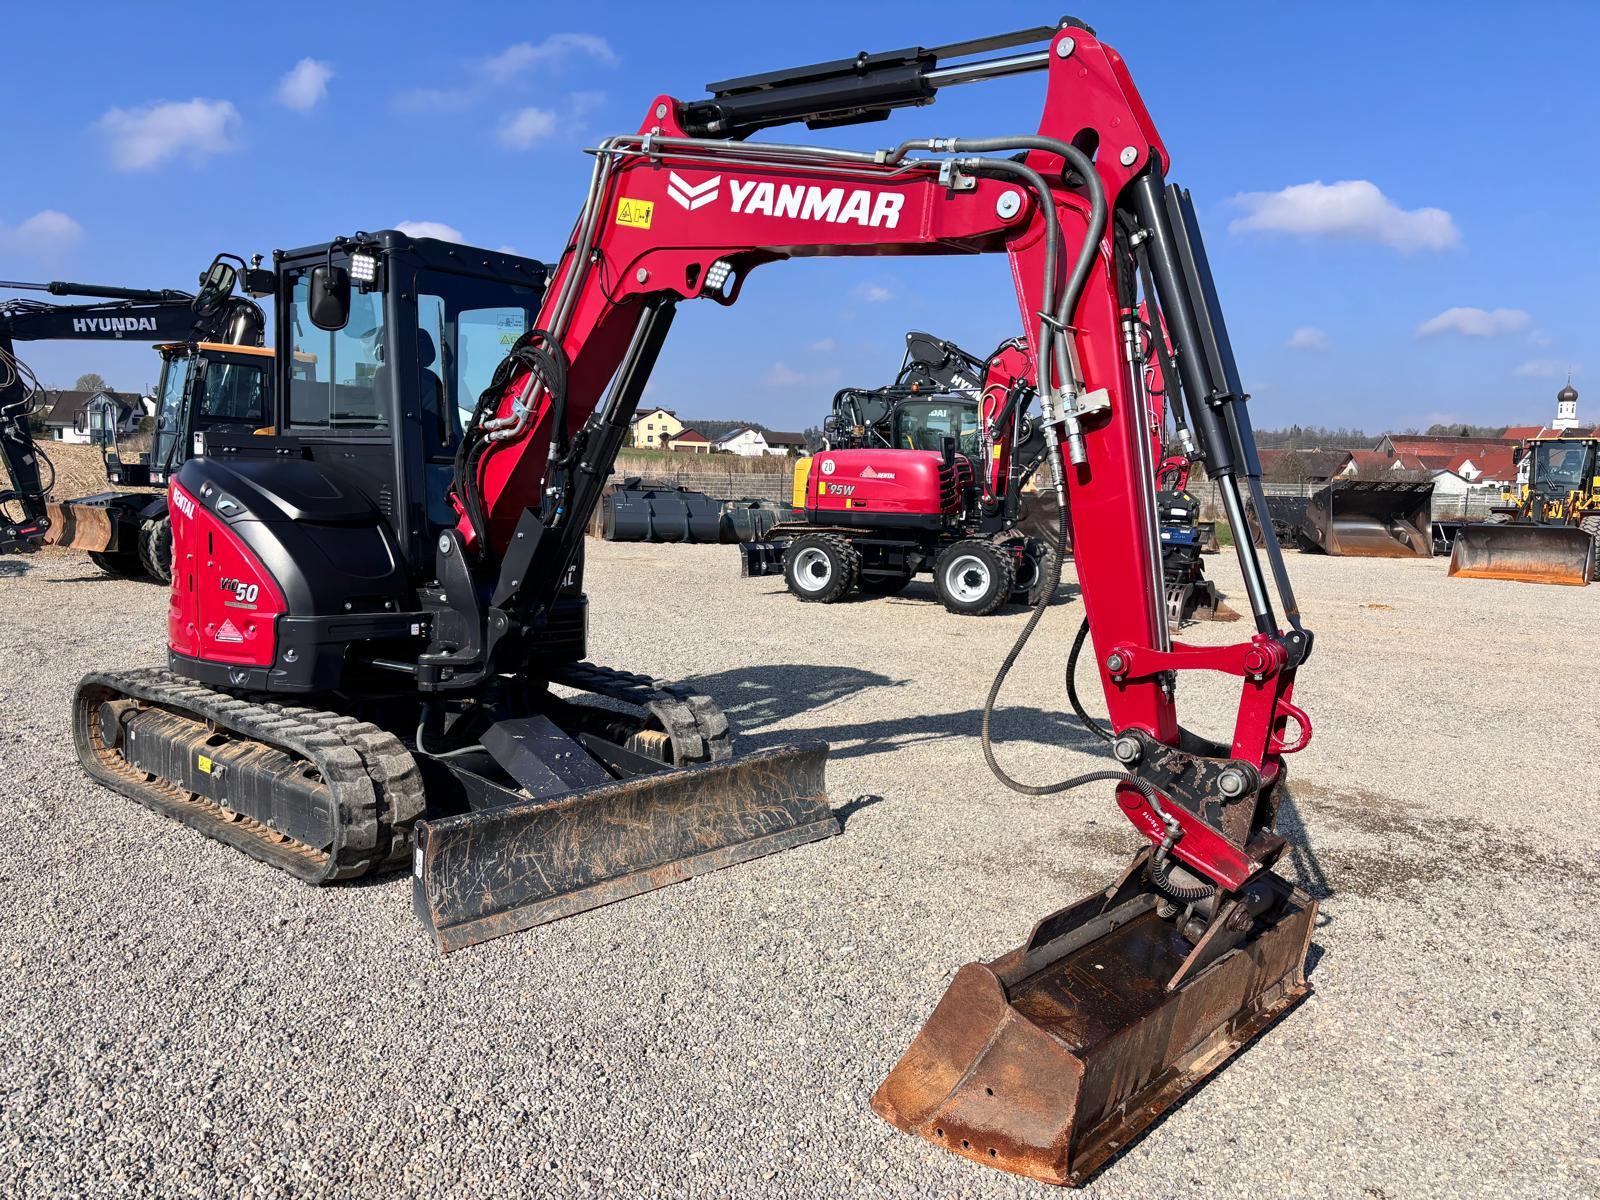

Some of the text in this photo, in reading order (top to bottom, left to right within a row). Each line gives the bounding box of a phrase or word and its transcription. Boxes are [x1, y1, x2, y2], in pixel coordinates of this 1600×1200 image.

[729, 179, 905, 229] YANMAR
[73, 317, 157, 332] HYUNDAI
[824, 462, 833, 472] 20
[173, 488, 195, 520] RENTAL
